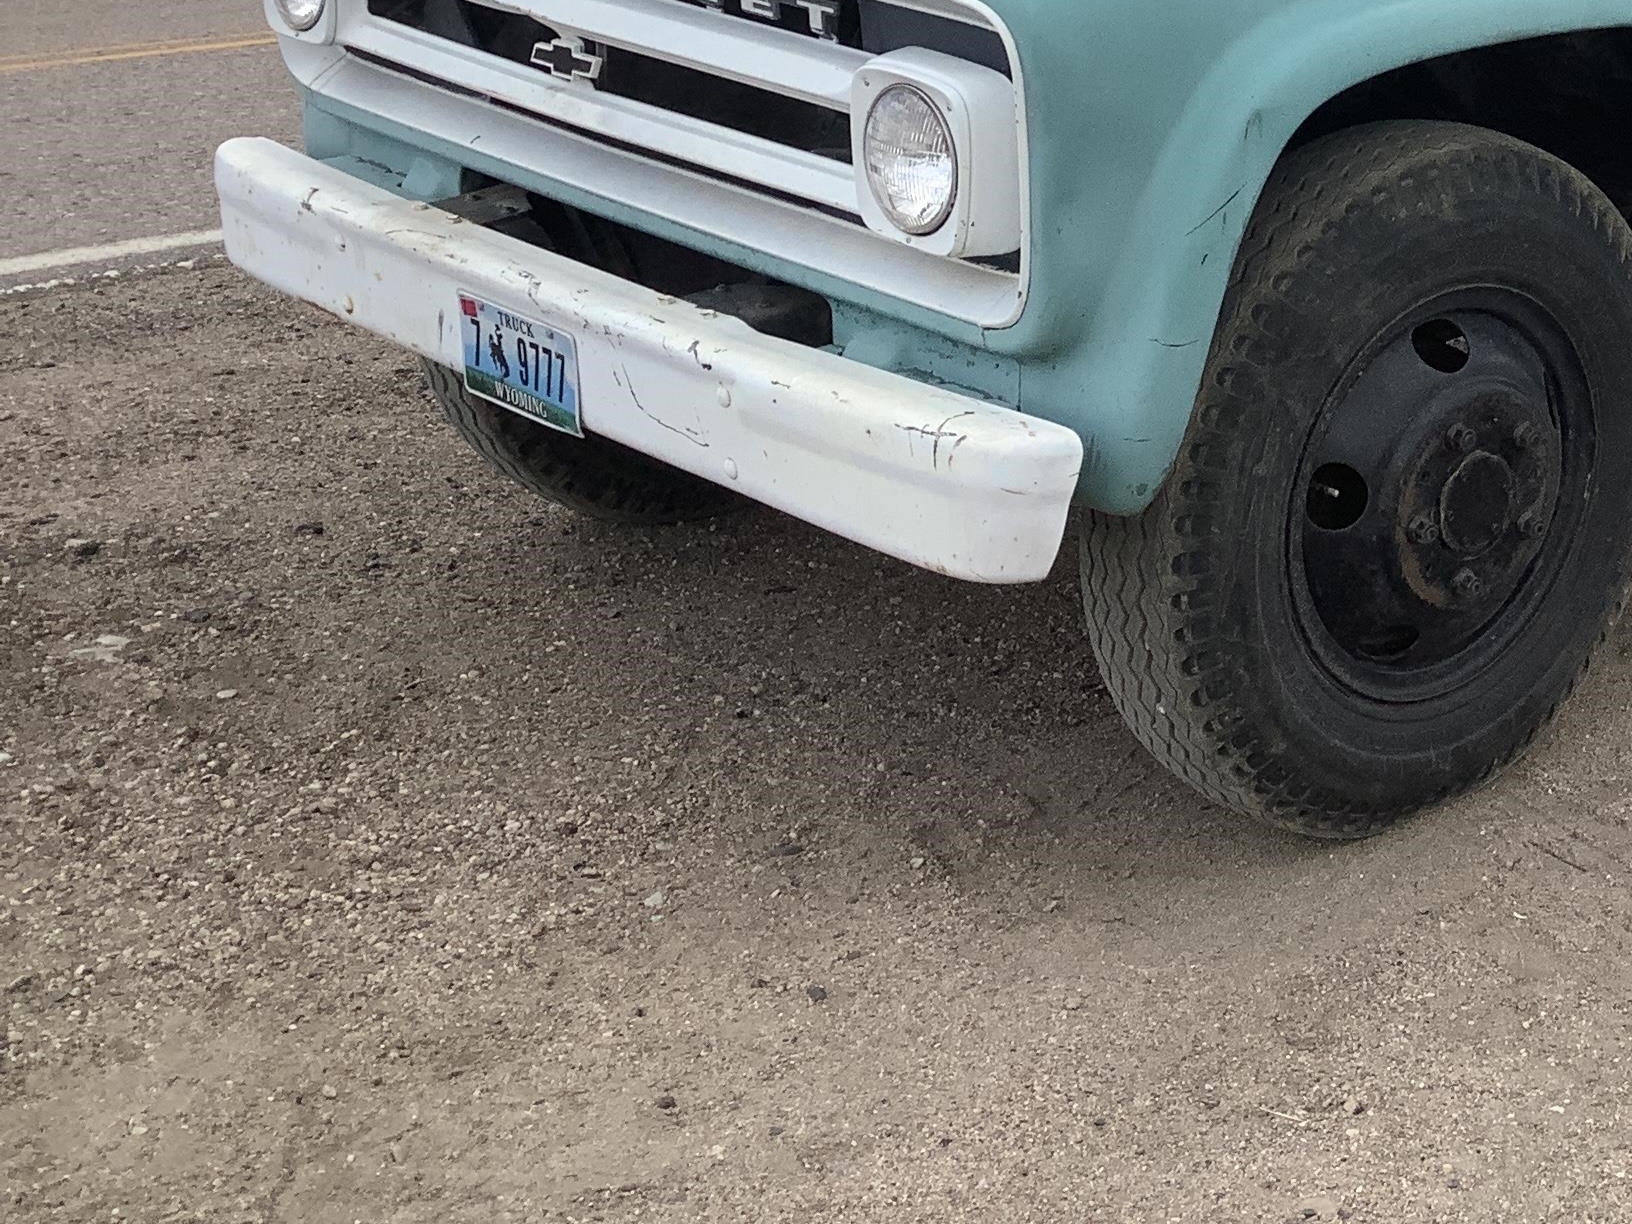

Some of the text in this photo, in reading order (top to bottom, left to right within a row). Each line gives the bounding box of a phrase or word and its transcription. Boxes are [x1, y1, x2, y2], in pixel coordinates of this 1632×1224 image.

[498, 311, 535, 338] TRUCK
[470, 318, 565, 403] 7 9777
[494, 380, 548, 418] WYOMING
